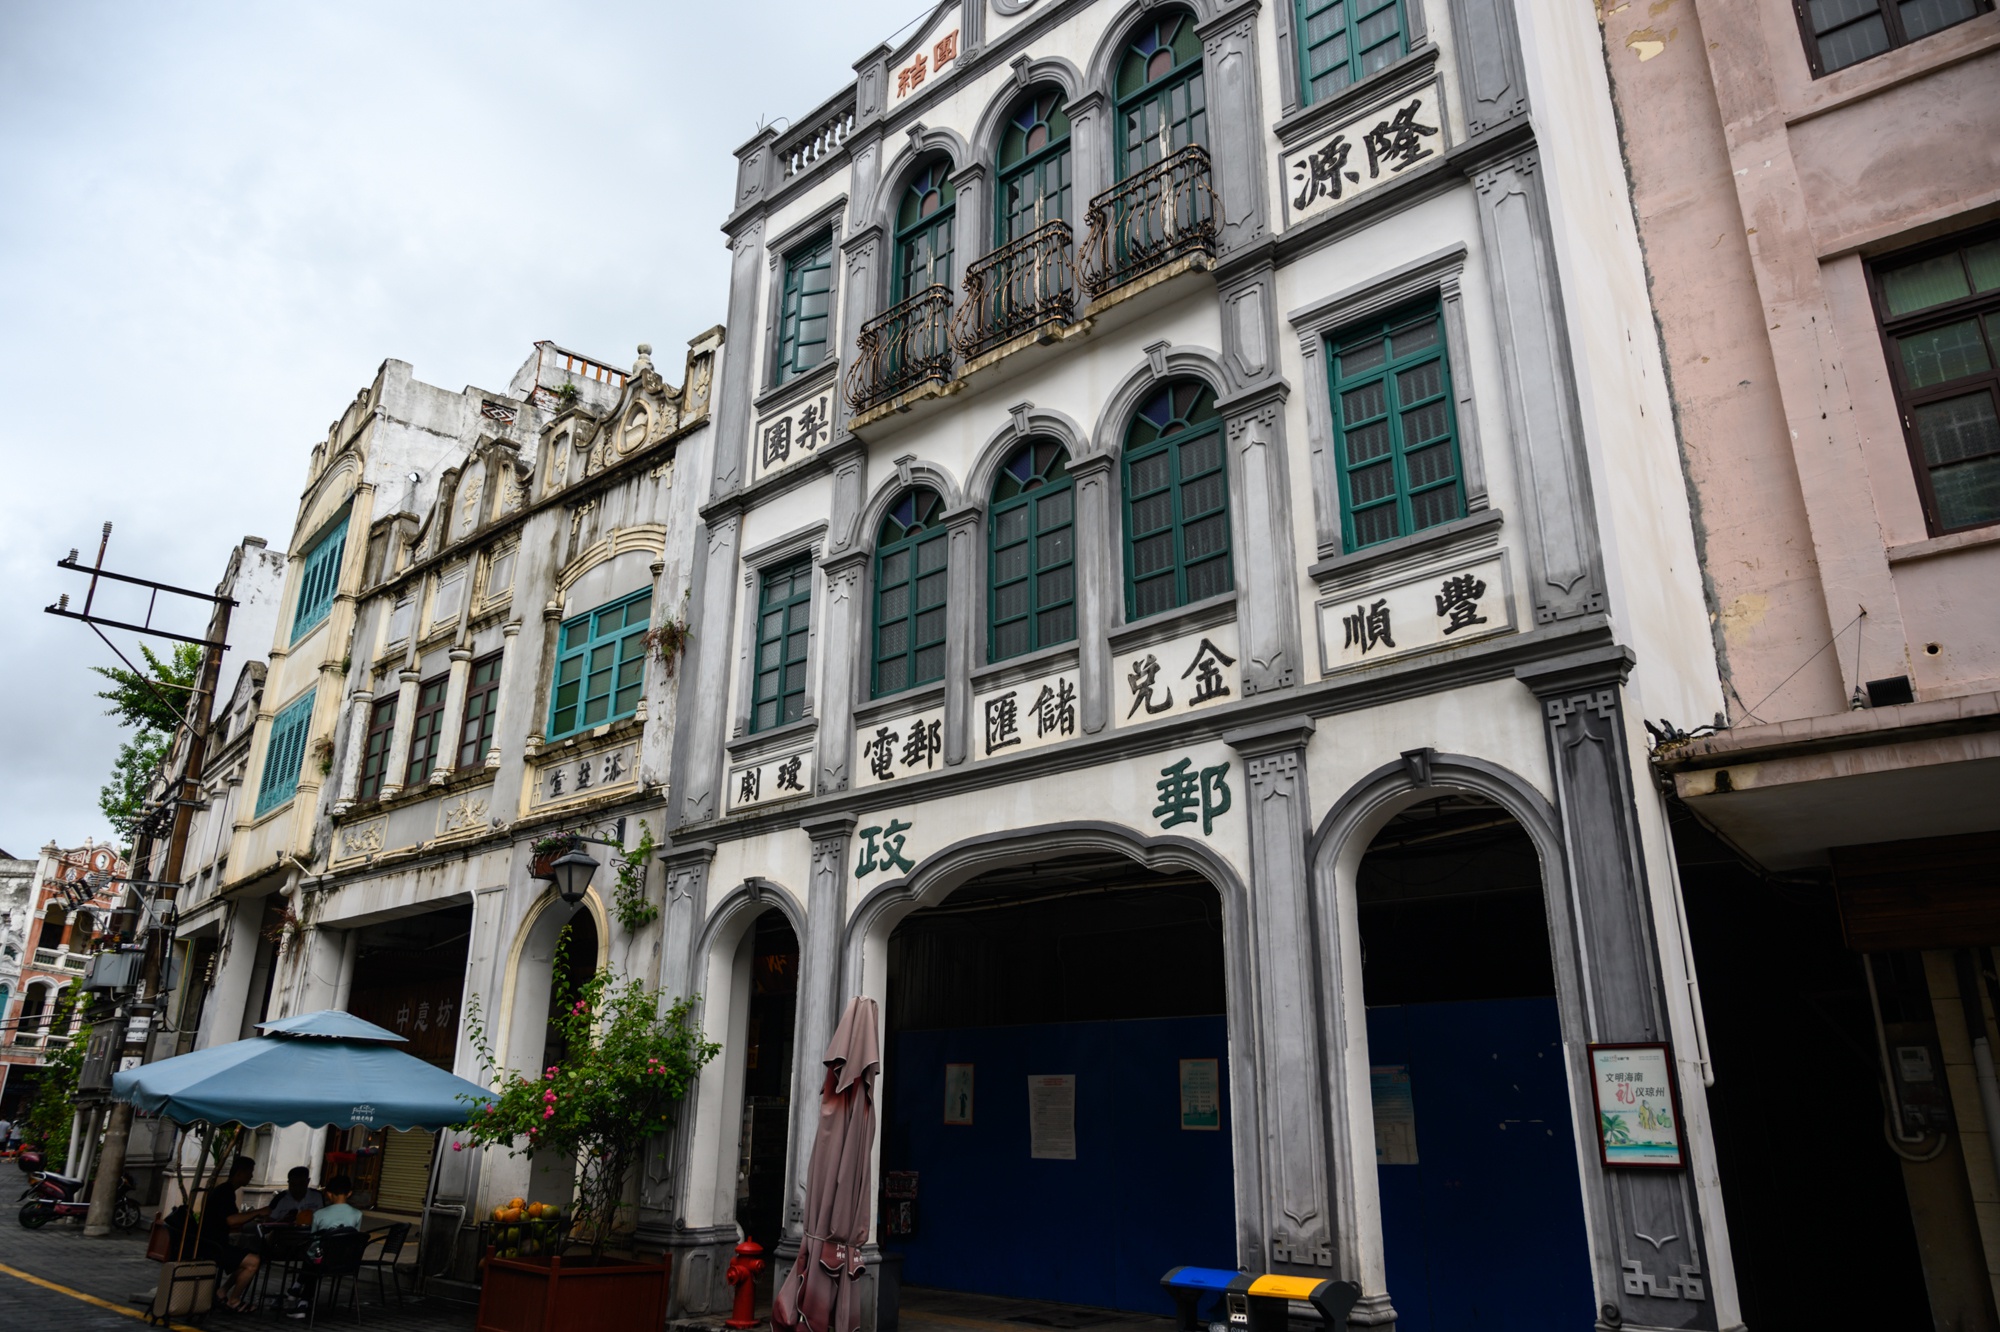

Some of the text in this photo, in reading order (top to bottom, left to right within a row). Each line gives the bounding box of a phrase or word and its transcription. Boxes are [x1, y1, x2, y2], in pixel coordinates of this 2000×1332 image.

[396, 996, 454, 1033] 中意坊
[1605, 1073, 1644, 1083] 文明海南
